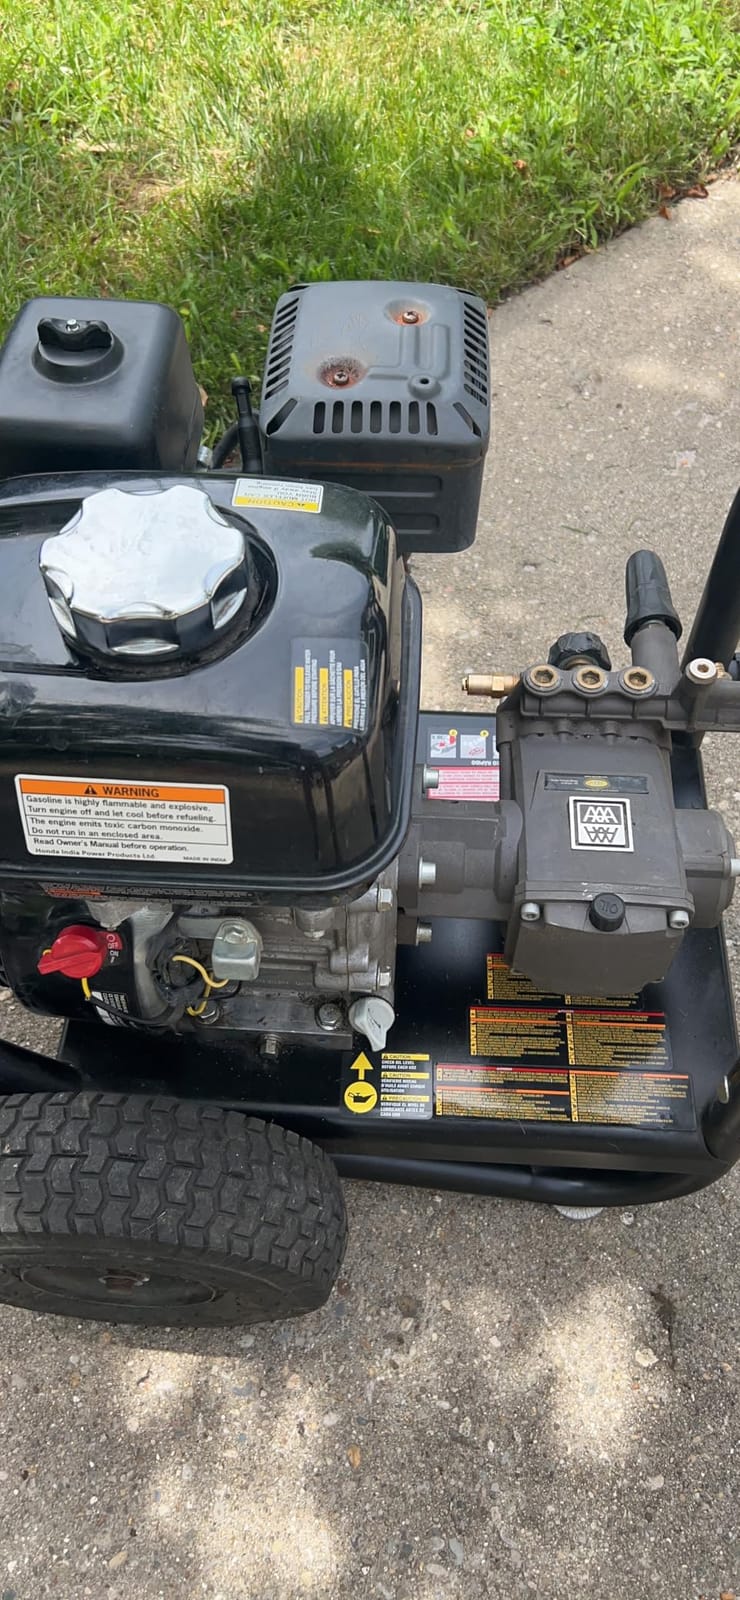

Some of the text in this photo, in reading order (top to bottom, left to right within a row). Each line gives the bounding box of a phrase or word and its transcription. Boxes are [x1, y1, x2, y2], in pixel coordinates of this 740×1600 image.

[102, 786, 159, 798] WARNING
[26, 795, 62, 804] Gasoline
[74, 798, 100, 807] highly
[102, 799, 148, 808] flammable
[169, 804, 211, 812] explosive.
[176, 814, 216, 822] refueling.
[160, 824, 203, 832] monoxide.
[56, 839, 88, 847] Owner's
[149, 844, 189, 852] operation.
